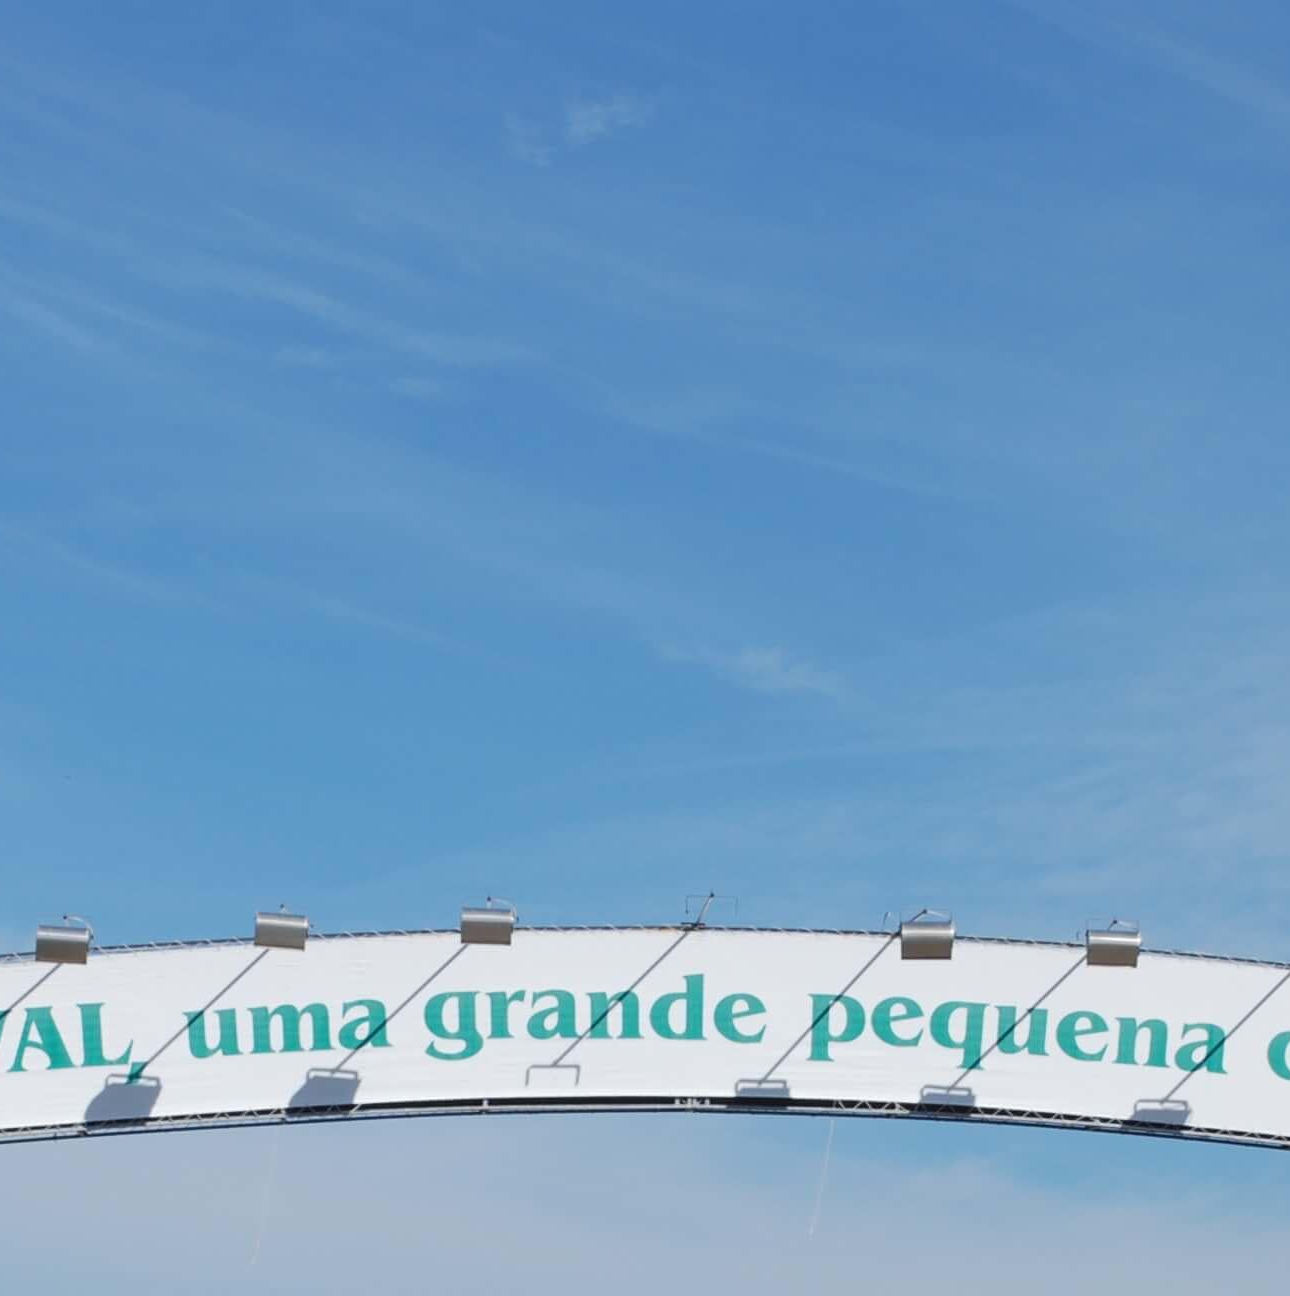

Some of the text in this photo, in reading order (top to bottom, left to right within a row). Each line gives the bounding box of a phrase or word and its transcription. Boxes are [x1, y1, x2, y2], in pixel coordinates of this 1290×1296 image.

[183, 998, 392, 1060] uma
[423, 972, 768, 1062] grande
[808, 992, 1230, 1072] pequena
